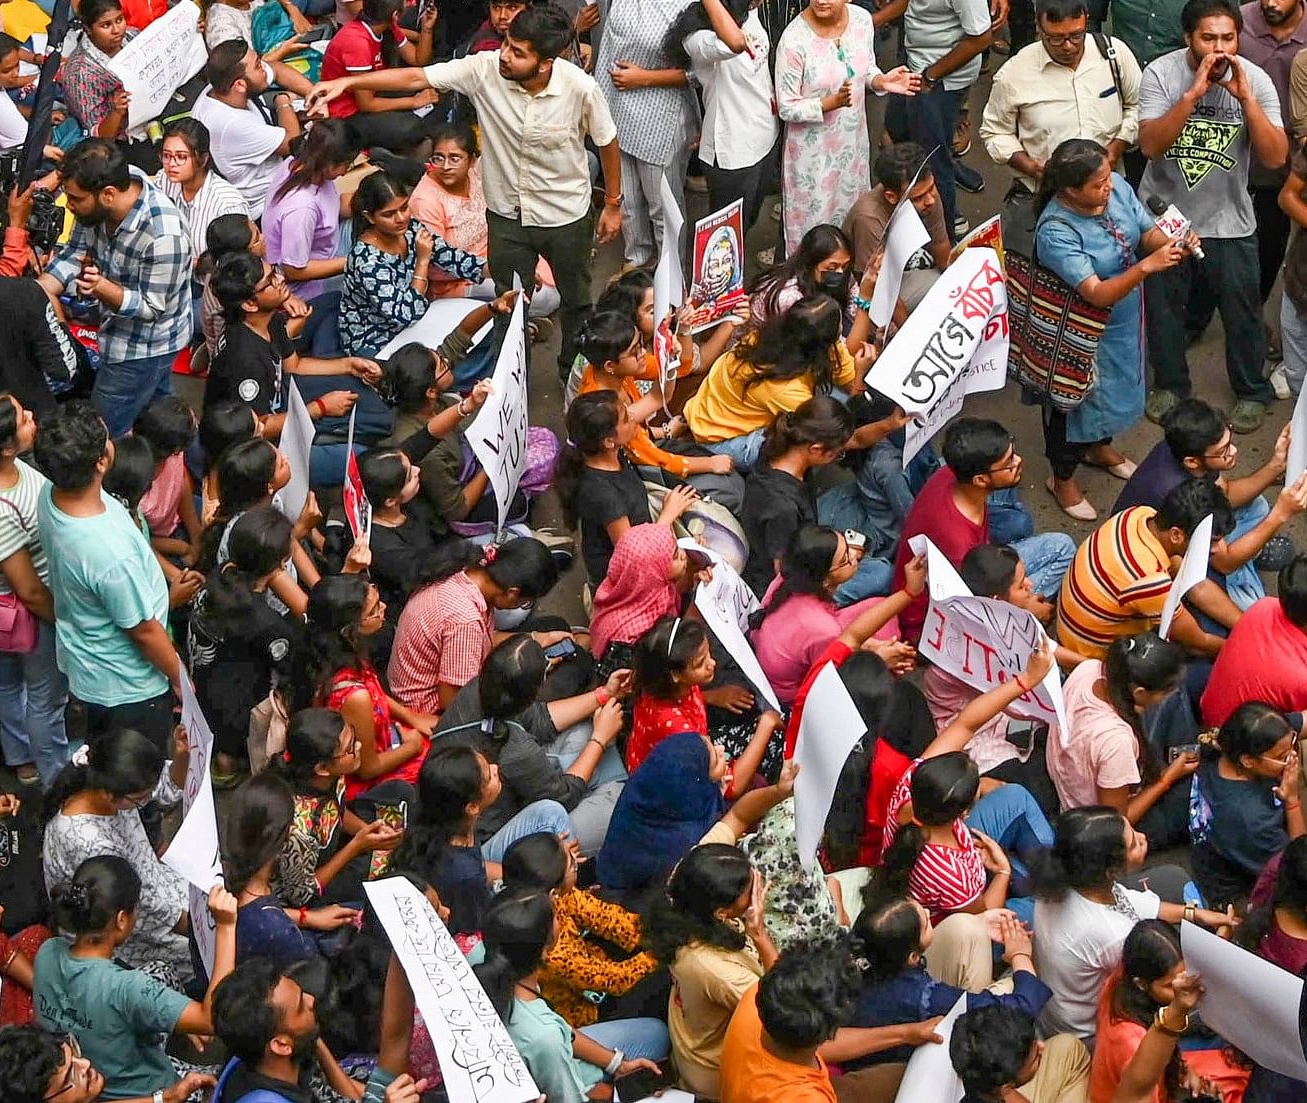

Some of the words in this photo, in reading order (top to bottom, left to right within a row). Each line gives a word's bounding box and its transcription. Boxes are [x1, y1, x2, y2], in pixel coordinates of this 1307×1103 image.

[1189, 148, 1232, 169] COMPETITION
[902, 311, 975, 404] আগে
[482, 393, 513, 456] WE
